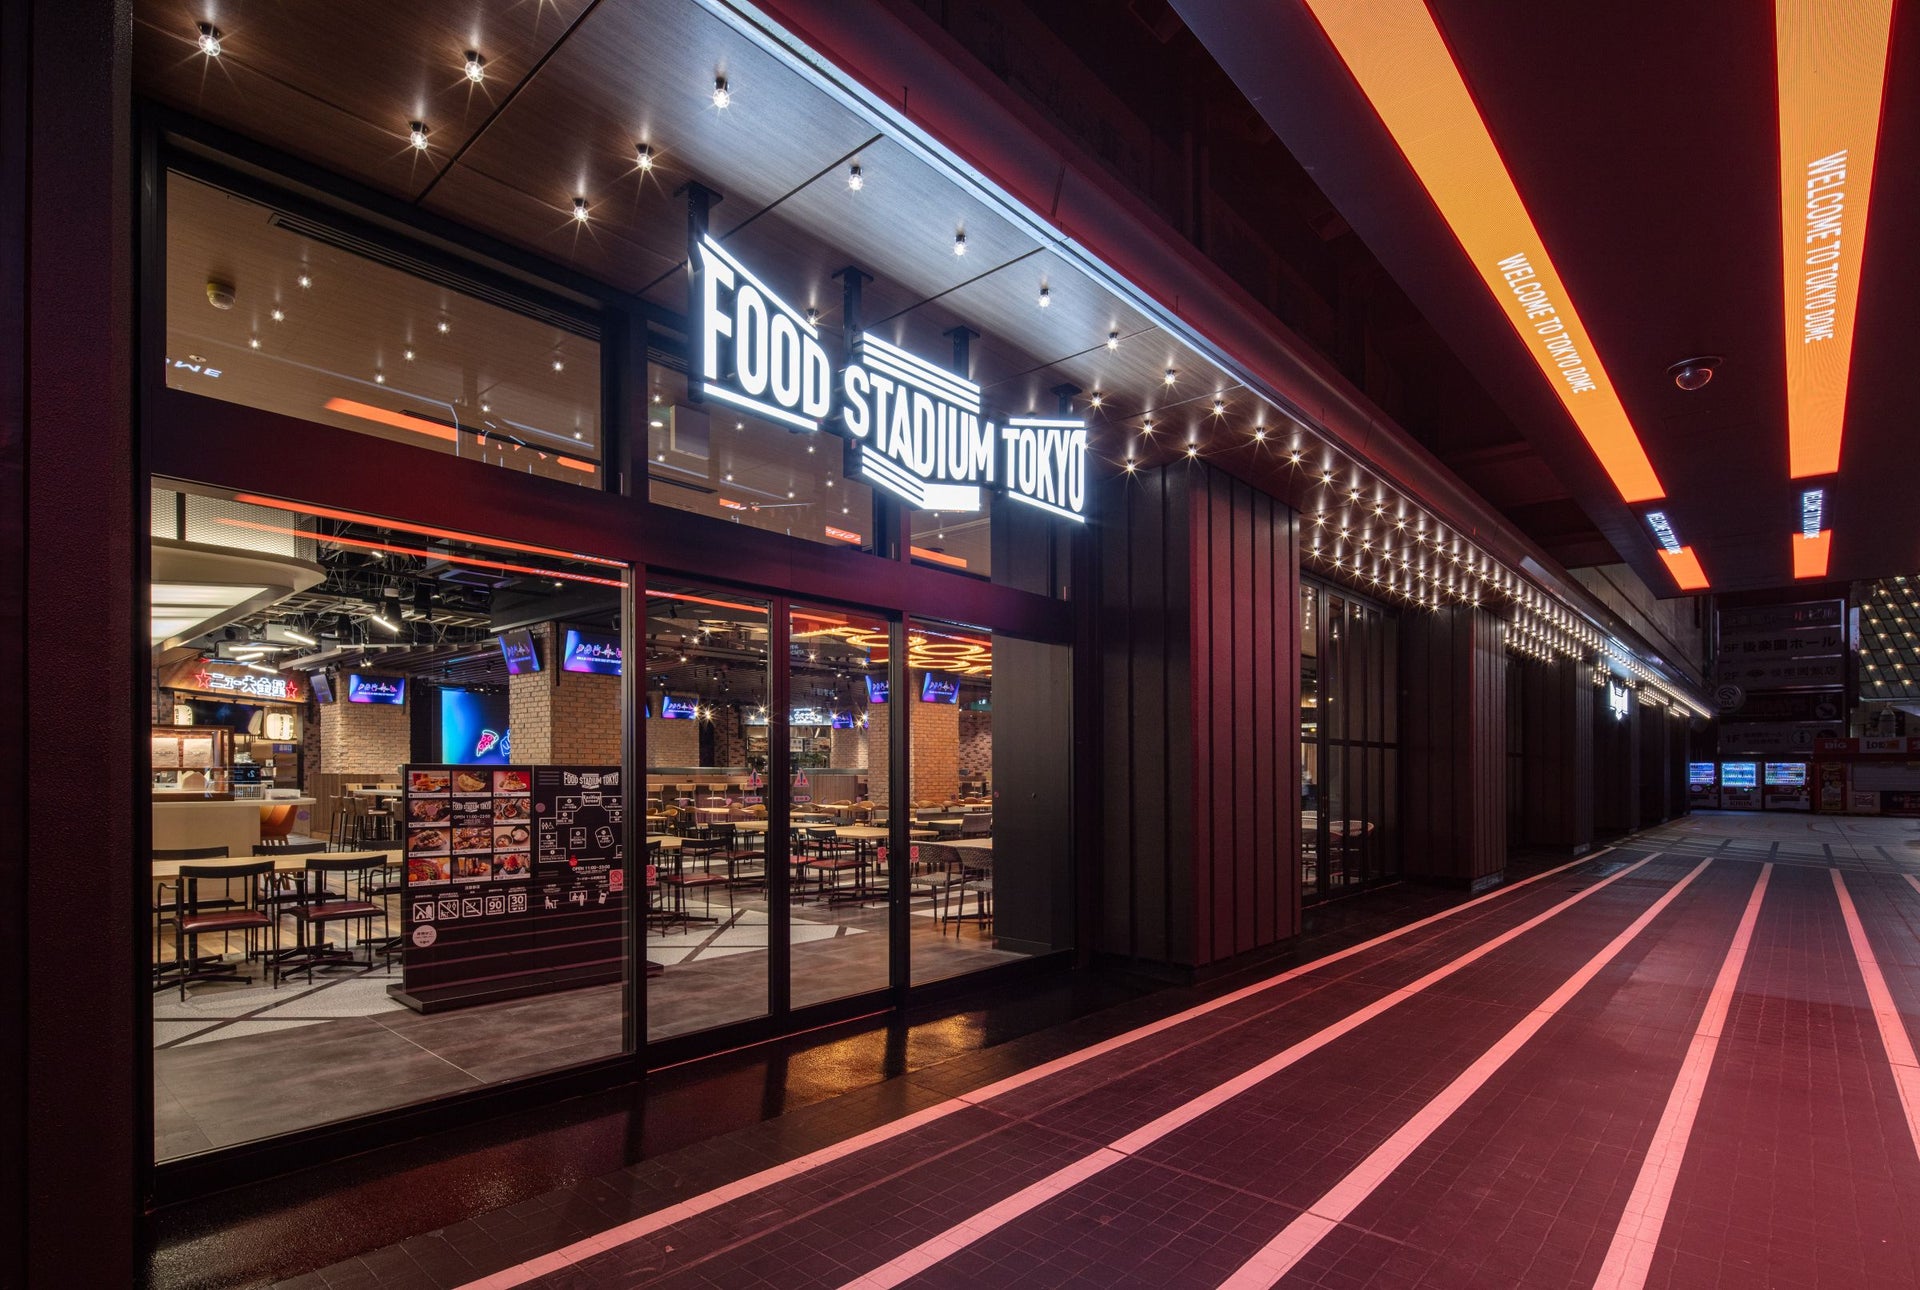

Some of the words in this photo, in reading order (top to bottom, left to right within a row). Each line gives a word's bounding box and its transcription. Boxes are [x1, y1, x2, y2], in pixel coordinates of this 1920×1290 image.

[1806, 149, 1848, 244] WELCOME
[1806, 240, 1841, 265] TO
[1497, 252, 1555, 319] WELCOME
[1804, 262, 1839, 310] TOKYO
[1534, 316, 1564, 335] TO
[1804, 308, 1836, 344] DOME
[1543, 332, 1583, 368] TOKYO
[698, 241, 831, 419] FOOD
[843, 365, 995, 483] STADIUM
[1002, 427, 1087, 513] TOKYO
[1561, 366, 1597, 394] DOME
[563, 771, 579, 786] FOOD
[579, 775, 602, 787] STADIUM
[602, 771, 619, 786] TOKYO
[488, 900, 502, 910] 90
[511, 895, 524, 905] 30
